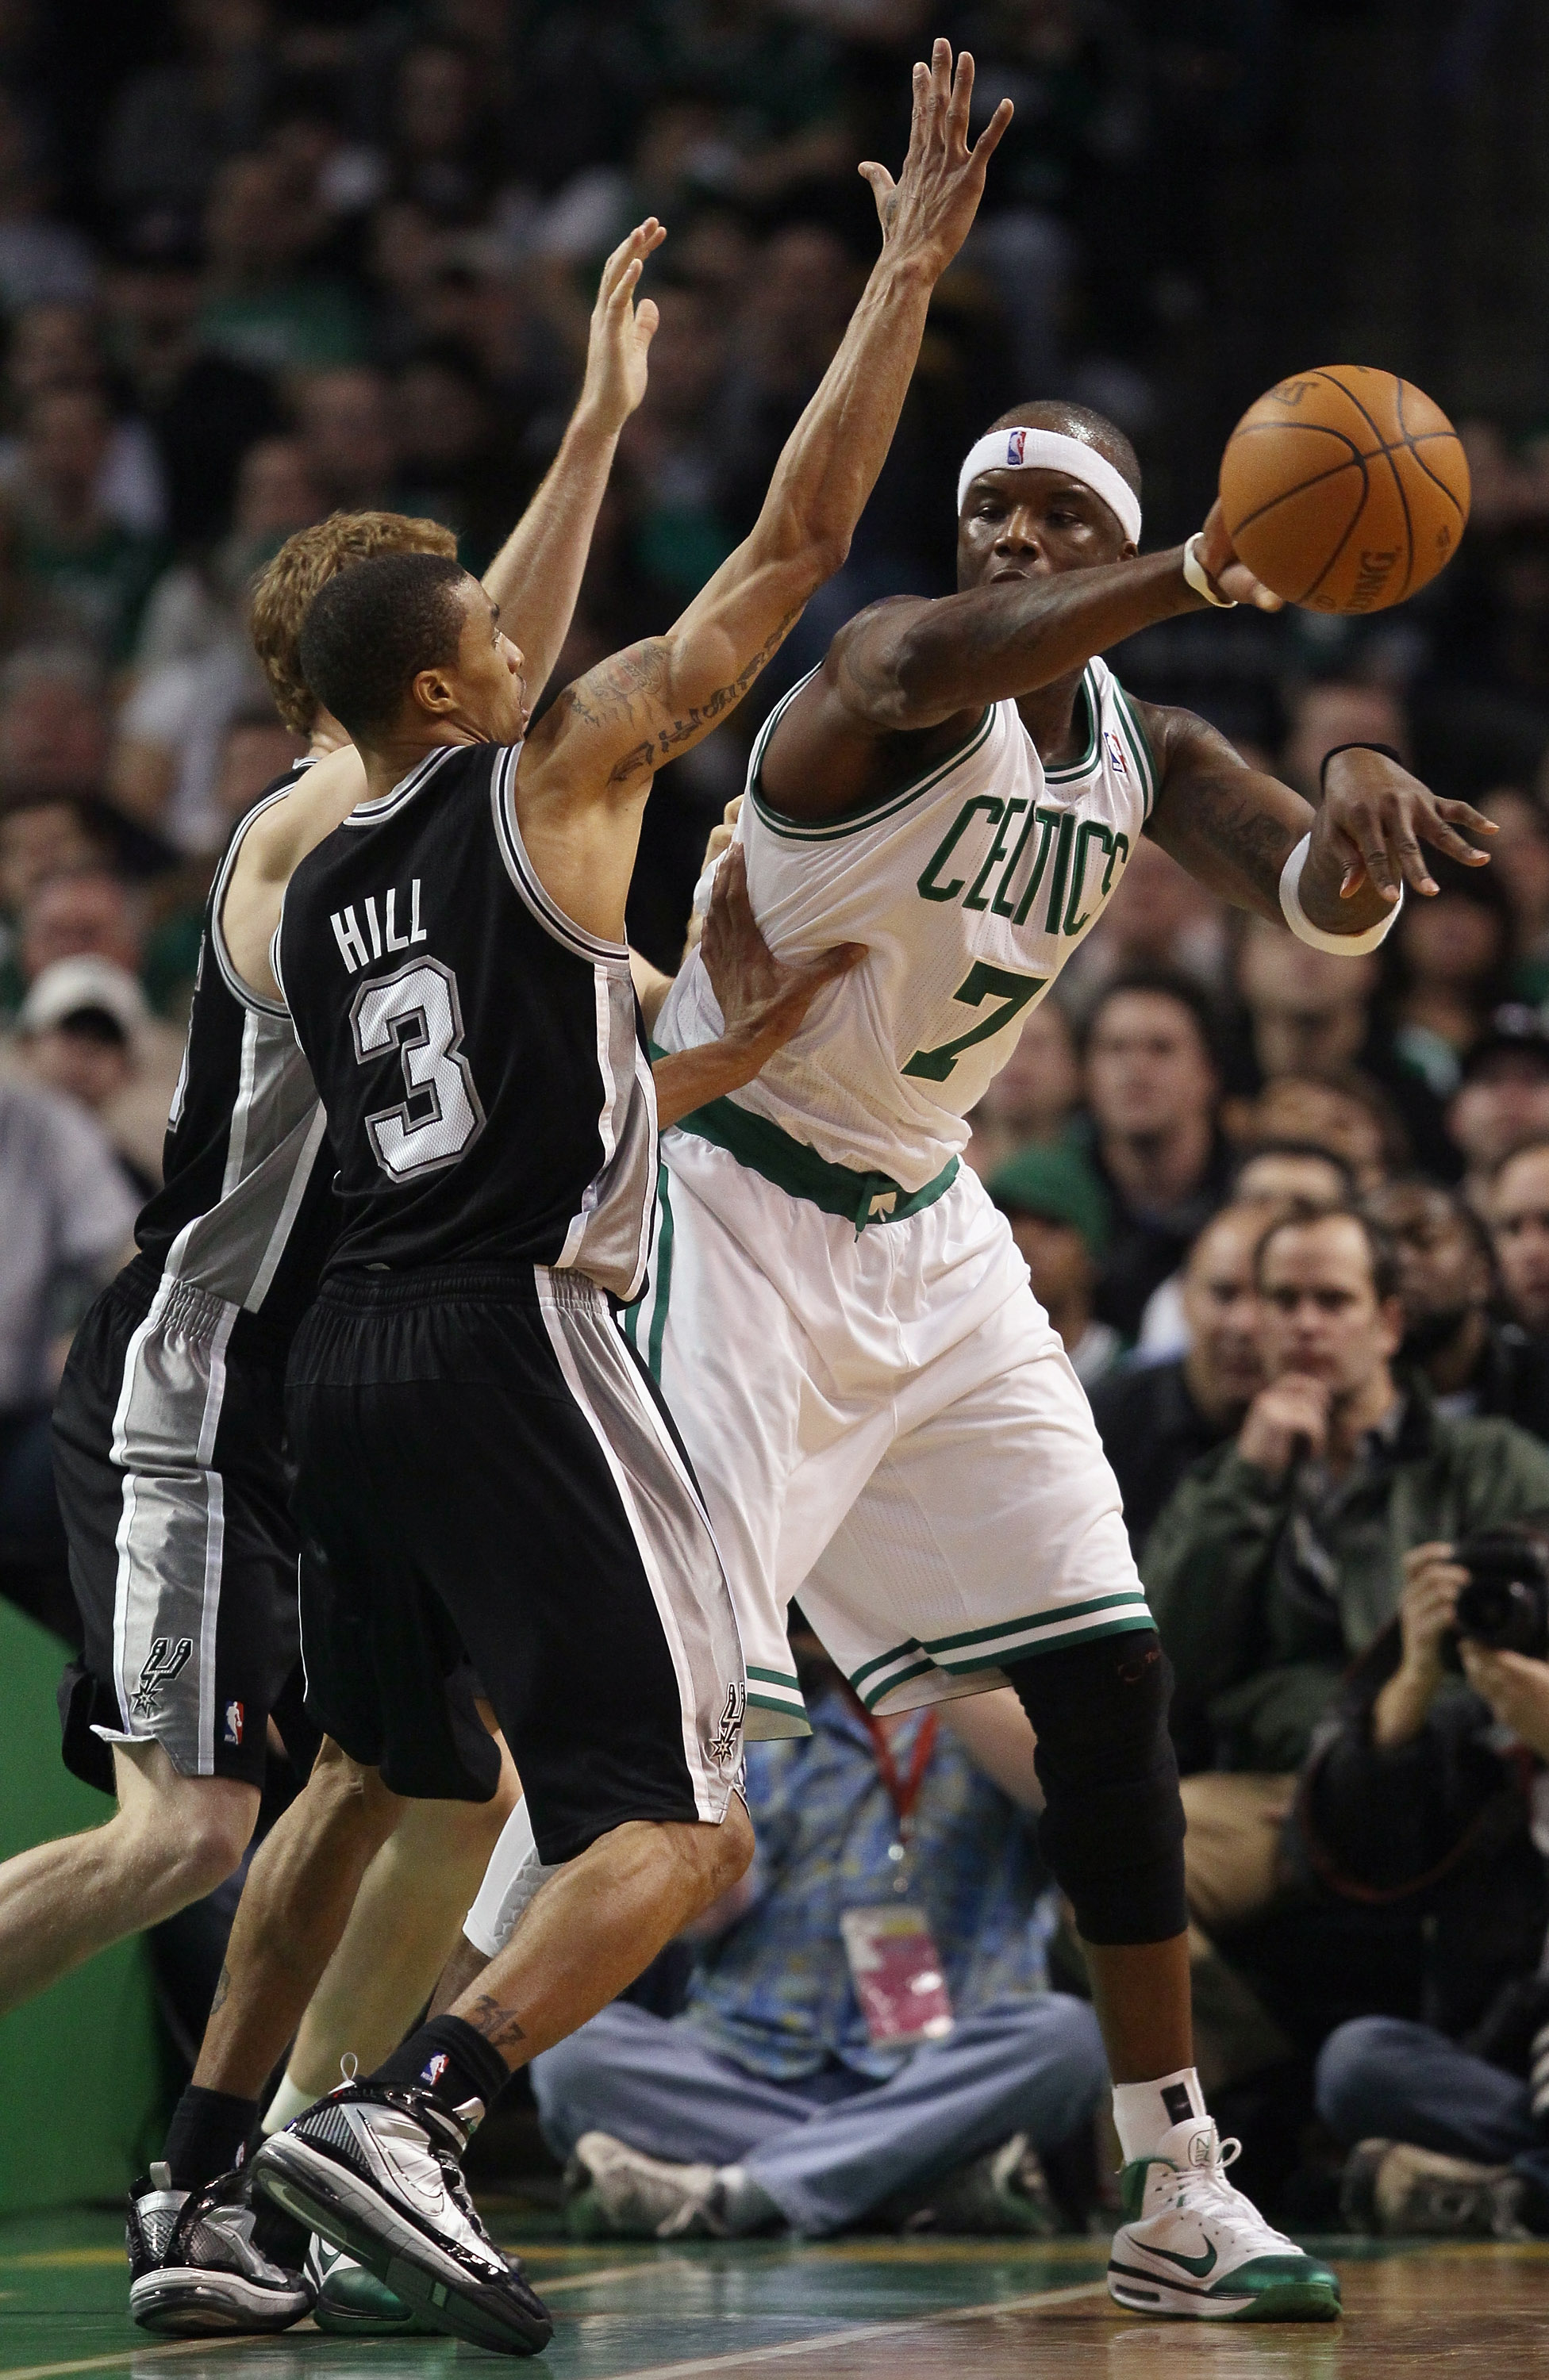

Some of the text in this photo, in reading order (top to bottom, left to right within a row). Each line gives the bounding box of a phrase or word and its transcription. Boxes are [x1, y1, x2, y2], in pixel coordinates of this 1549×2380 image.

[329, 878, 427, 974] HILL
[348, 954, 487, 1184] 3
[900, 960, 1049, 1082] 7
